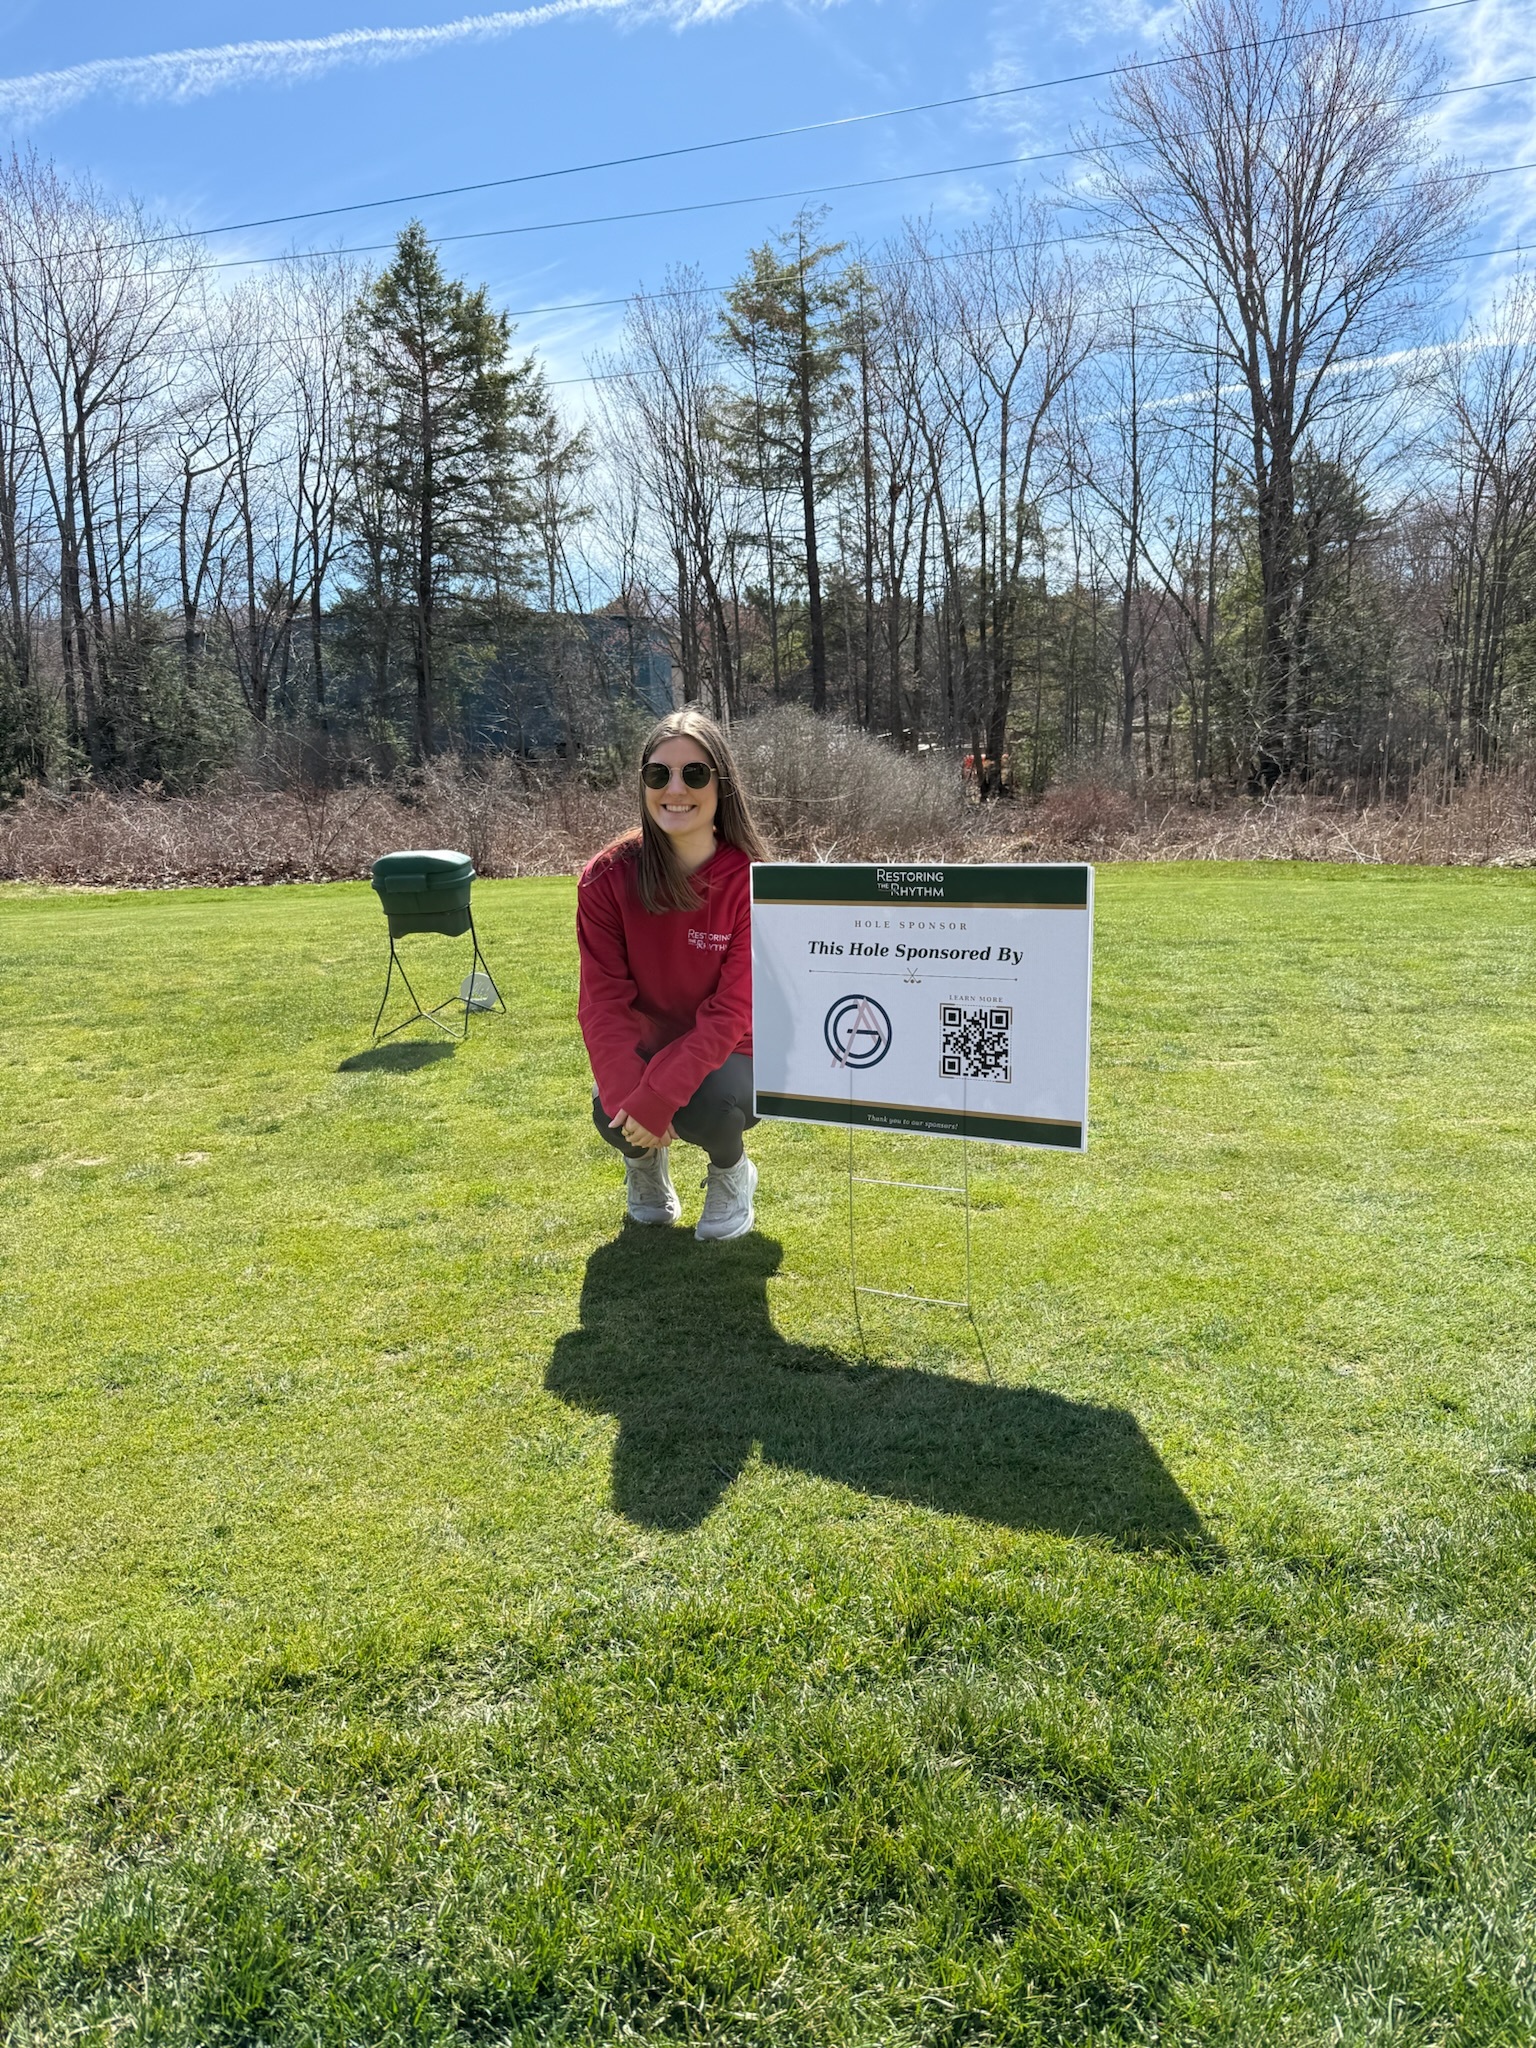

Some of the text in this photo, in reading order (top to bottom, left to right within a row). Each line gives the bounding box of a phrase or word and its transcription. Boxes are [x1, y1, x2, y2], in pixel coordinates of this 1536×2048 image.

[876, 868, 944, 882] RESTORING
[890, 883, 944, 897] RHYTHM
[854, 920, 968, 931] HOLE SPONSOR
[808, 941, 1023, 965] This Hole Sponsored By
[867, 1114, 888, 1123] Thank
